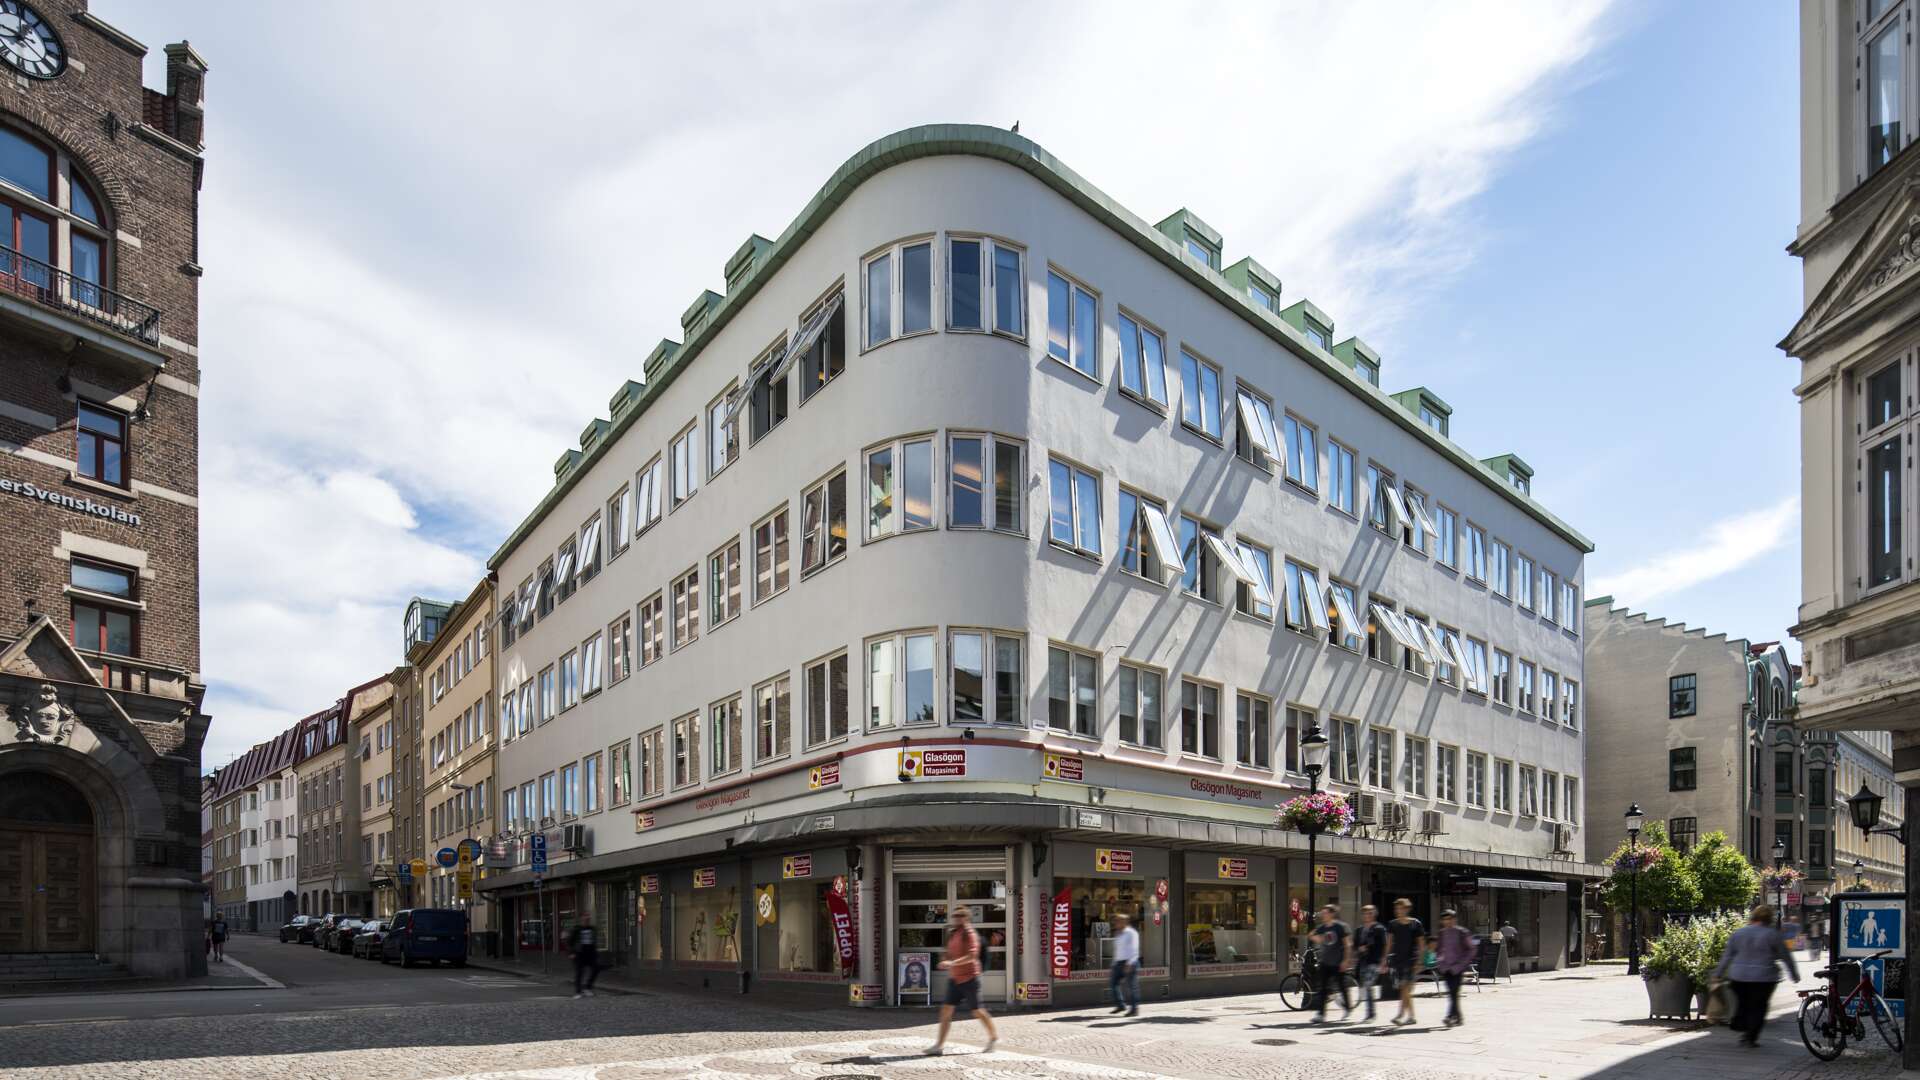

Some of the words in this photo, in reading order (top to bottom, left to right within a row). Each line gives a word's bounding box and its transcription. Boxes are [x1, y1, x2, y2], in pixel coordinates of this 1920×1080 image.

[925, 753, 963, 766] Glasögon
[1060, 758, 1081, 770] Glasögon
[925, 767, 959, 775] Magasinet
[1191, 779, 1226, 796] Glasögon
[1226, 785, 1262, 800] Magasinet
[534, 837, 543, 849] P
[834, 913, 853, 958] ÖPPET
[1054, 902, 1069, 966] OPTIKER
